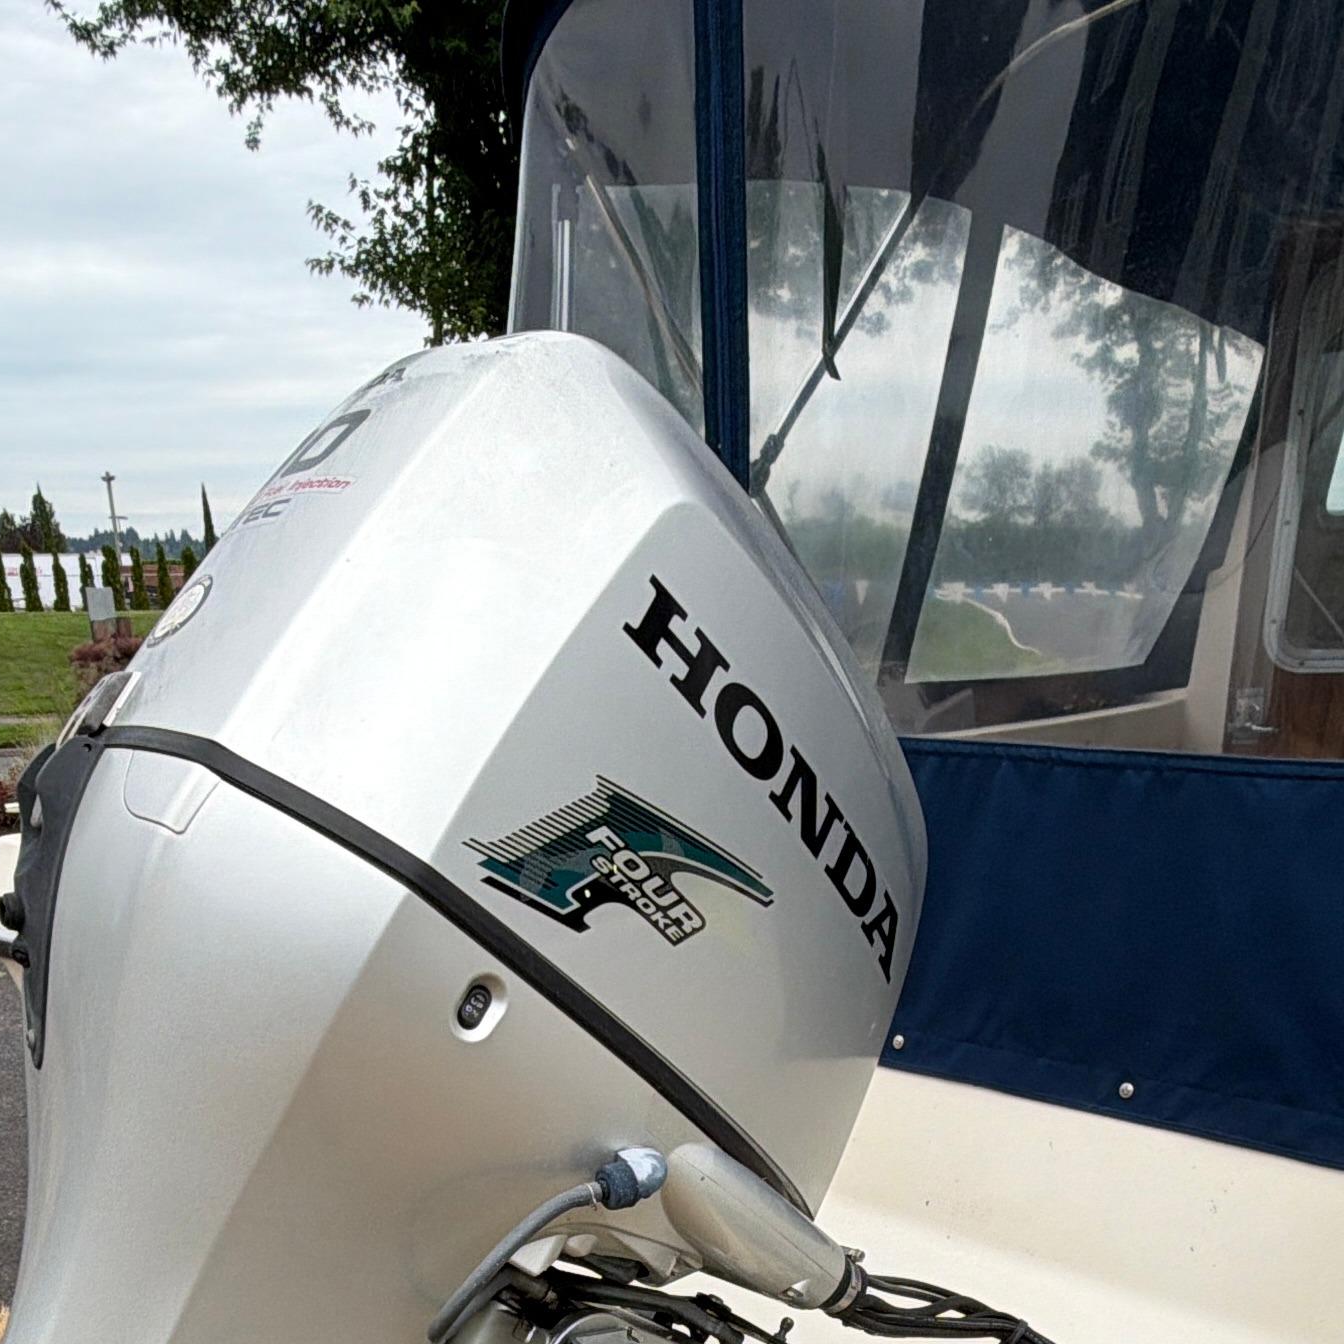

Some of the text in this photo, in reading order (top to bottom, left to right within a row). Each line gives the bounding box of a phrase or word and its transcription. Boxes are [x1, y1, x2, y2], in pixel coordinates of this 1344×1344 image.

[622, 574, 899, 985] HONDA
[585, 825, 703, 933] FOUR
[591, 855, 685, 943] STROKE
